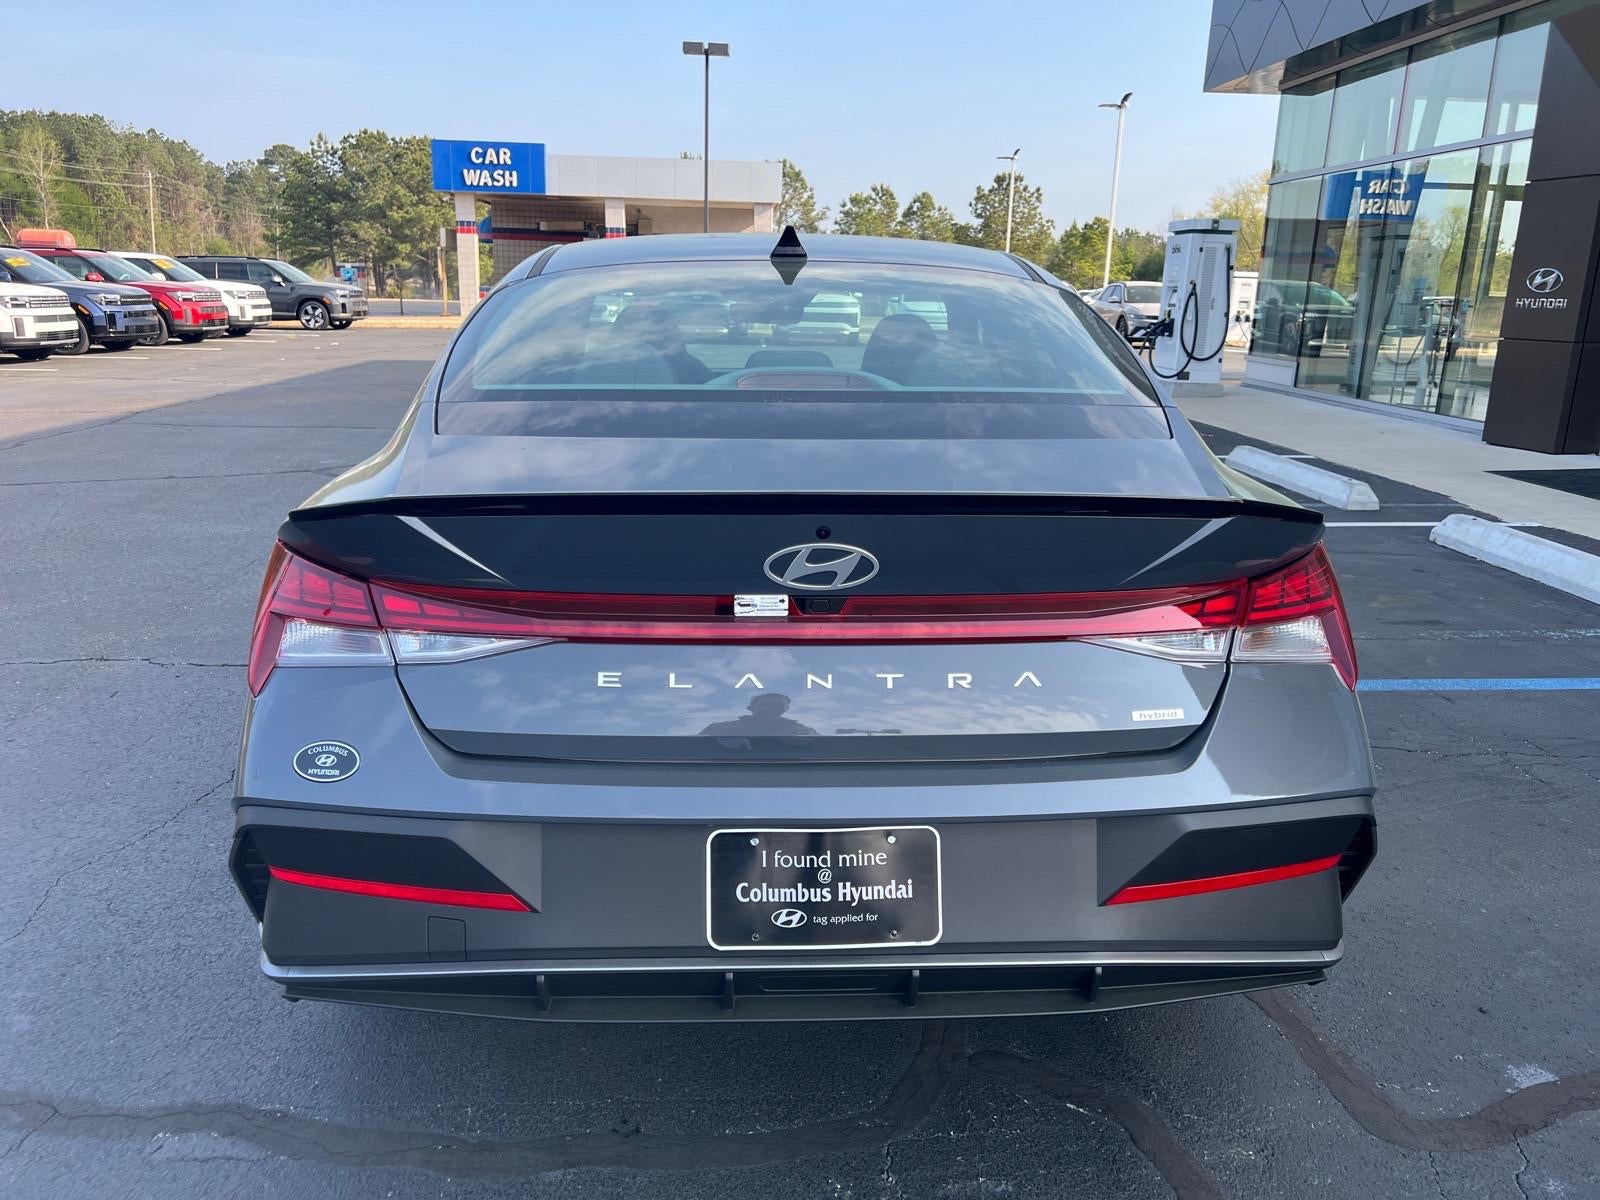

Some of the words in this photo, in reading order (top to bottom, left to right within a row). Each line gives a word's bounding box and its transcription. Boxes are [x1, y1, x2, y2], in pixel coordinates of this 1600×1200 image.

[470, 147, 512, 165] CAR
[463, 168, 518, 187] WASH
[1515, 298, 1568, 309] HYUNDAI
[597, 671, 1042, 689] ELANTRA
[1139, 711, 1178, 720] hybrid
[308, 746, 348, 757] COLUMBUS
[762, 851, 767, 868] I
[774, 850, 831, 868] found
[838, 850, 887, 867] mine
[817, 868, 832, 884] @
[735, 882, 832, 903] Columbus
[838, 879, 913, 906] Hyundai
[813, 915, 828, 925] tag
[829, 913, 864, 924] applied
[866, 912, 878, 922] for
